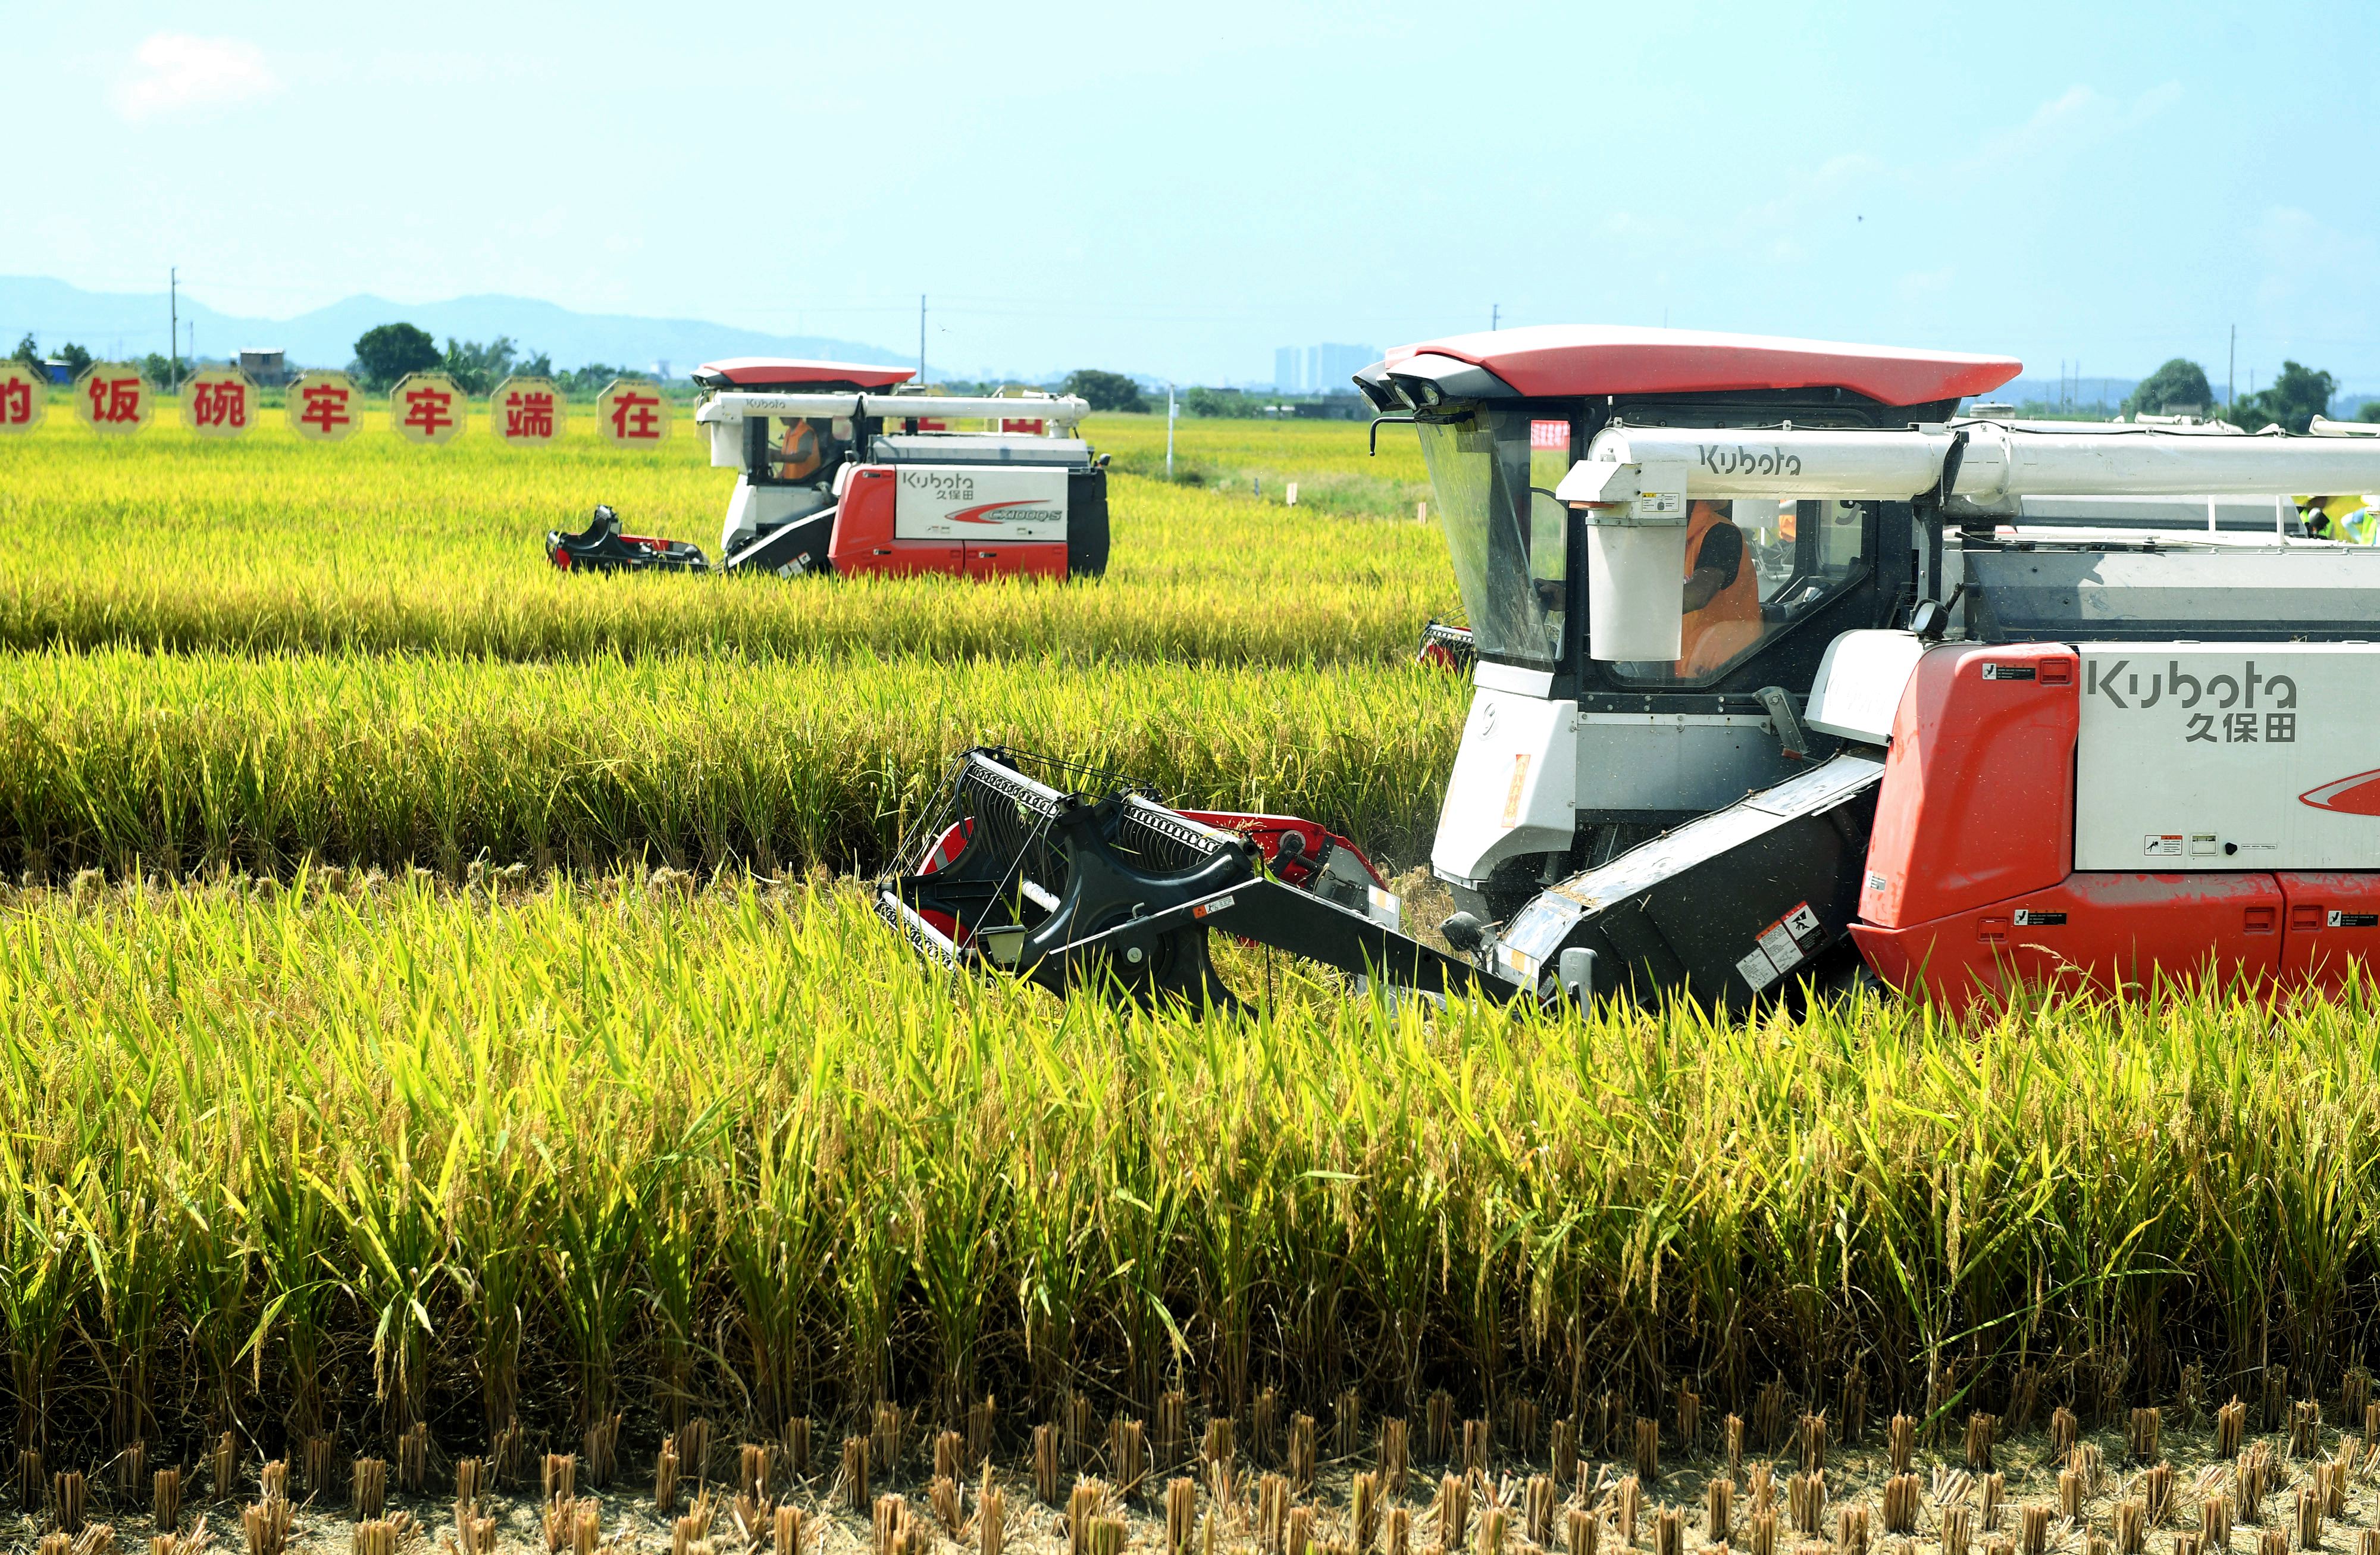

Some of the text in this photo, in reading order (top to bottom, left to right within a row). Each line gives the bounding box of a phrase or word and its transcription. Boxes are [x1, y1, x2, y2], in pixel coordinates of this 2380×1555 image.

[89, 377, 140, 423] 饭
[193, 380, 246, 427] 碗
[301, 384, 350, 433] 牢
[405, 387, 453, 435] 牢
[506, 391, 553, 438] 端
[611, 392, 660, 439] 在
[746, 398, 786, 409] Kubota
[1699, 444, 1802, 476] Kubota
[903, 472, 973, 489] Kubota
[937, 490, 973, 500] 久保田
[2087, 660, 2297, 709] Kubota
[2185, 713, 2297, 743] 久保田
